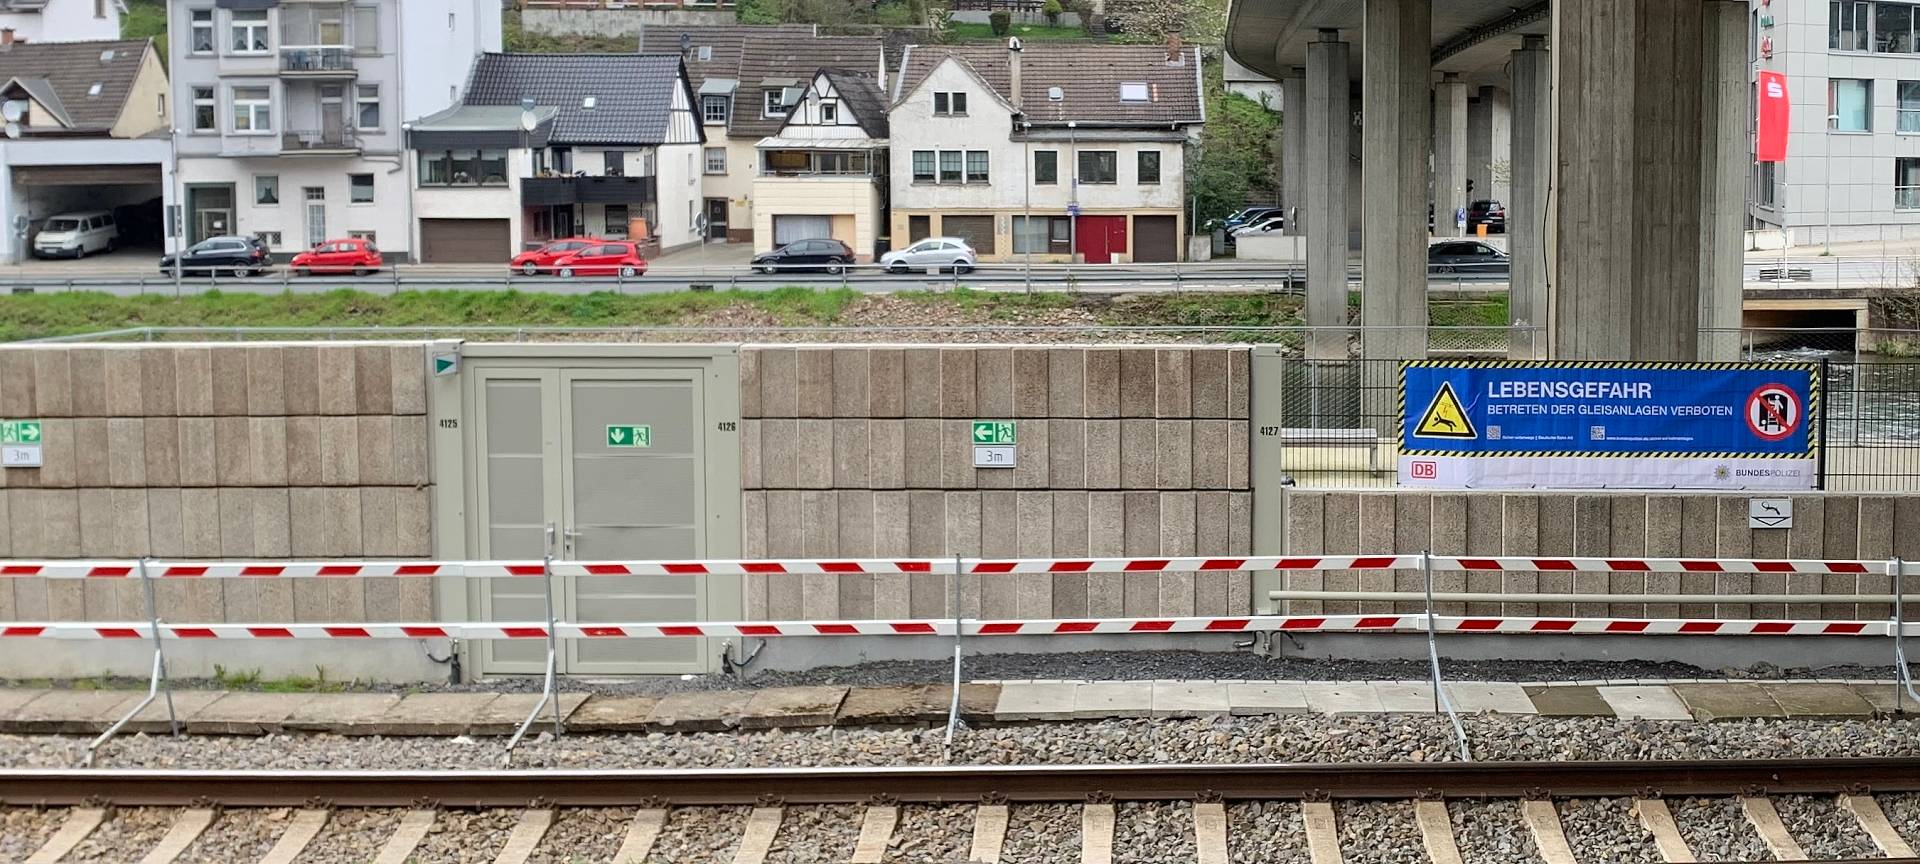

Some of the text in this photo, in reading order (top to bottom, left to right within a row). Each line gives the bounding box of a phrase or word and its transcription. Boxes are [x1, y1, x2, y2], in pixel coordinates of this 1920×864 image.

[1487, 381, 1652, 399] LEBENSGEFAHR
[1487, 404, 1733, 416] BETRETEN DER GLEISANLAGEN VERBOTEN
[439, 419, 458, 428] 4125
[718, 422, 736, 432] 4126
[1260, 426, 1279, 436] 4127
[1414, 464, 1434, 476] DB
[1735, 469, 1801, 477] BUNDESPOLIZEI
